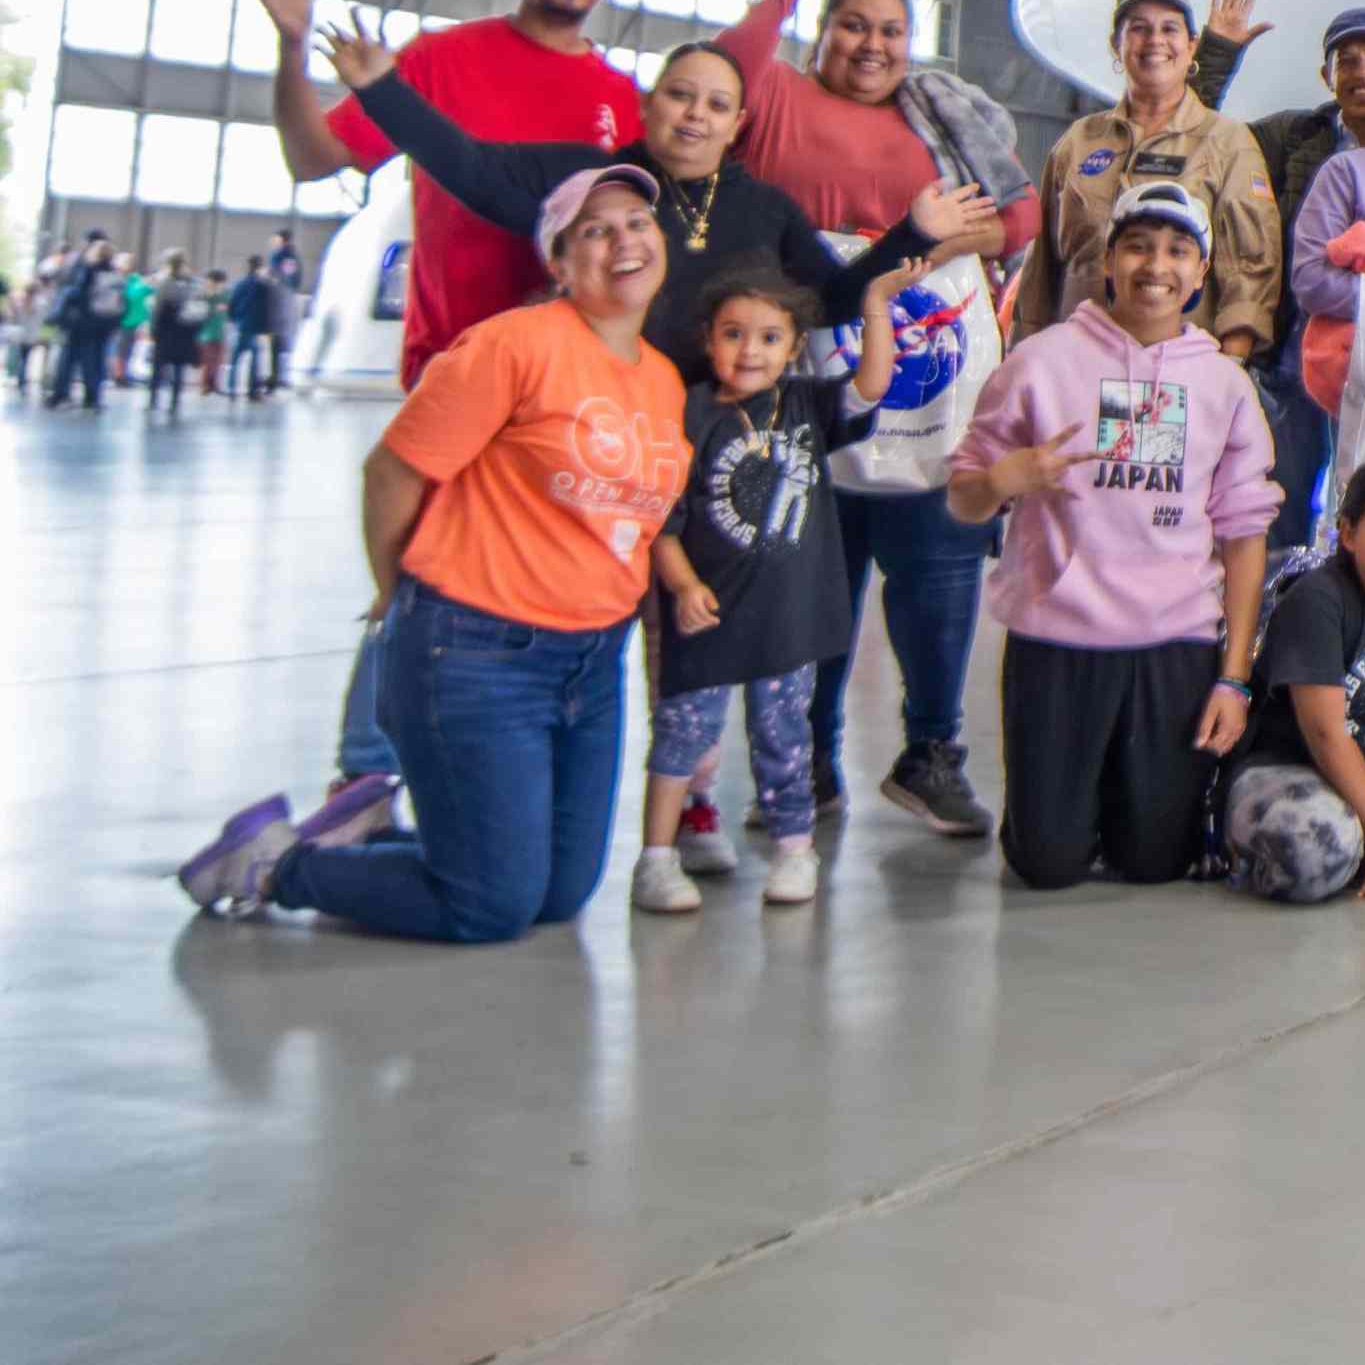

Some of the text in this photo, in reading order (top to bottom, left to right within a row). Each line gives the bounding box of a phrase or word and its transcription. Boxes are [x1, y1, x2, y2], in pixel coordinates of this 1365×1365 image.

[847, 321, 961, 358] NSA
[552, 470, 624, 502] OPEN
[711, 473, 731, 496] IS
[1093, 462, 1184, 493] JAPAN
[712, 496, 758, 546] SPACE
[1153, 505, 1184, 519] JAPAN
